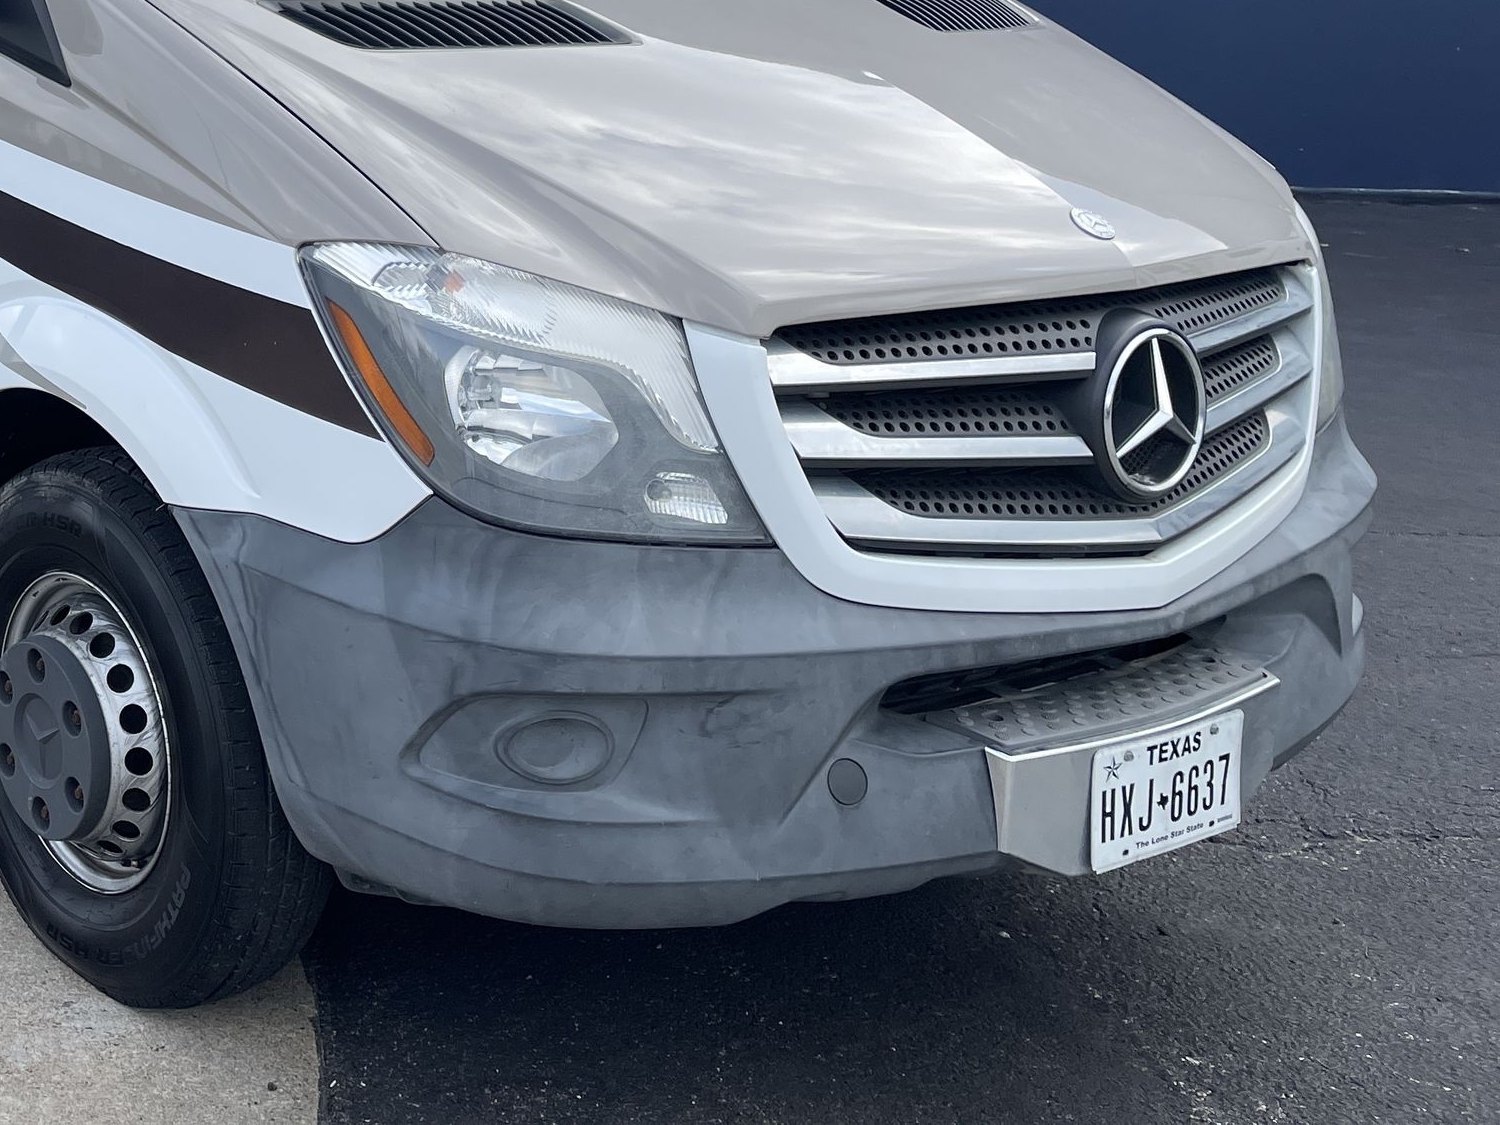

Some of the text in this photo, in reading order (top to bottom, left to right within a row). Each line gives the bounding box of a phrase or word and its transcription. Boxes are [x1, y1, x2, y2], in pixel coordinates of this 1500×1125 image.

[1146, 731, 1202, 766] TEXAS
[1135, 822, 1204, 849] The Lone Star State
